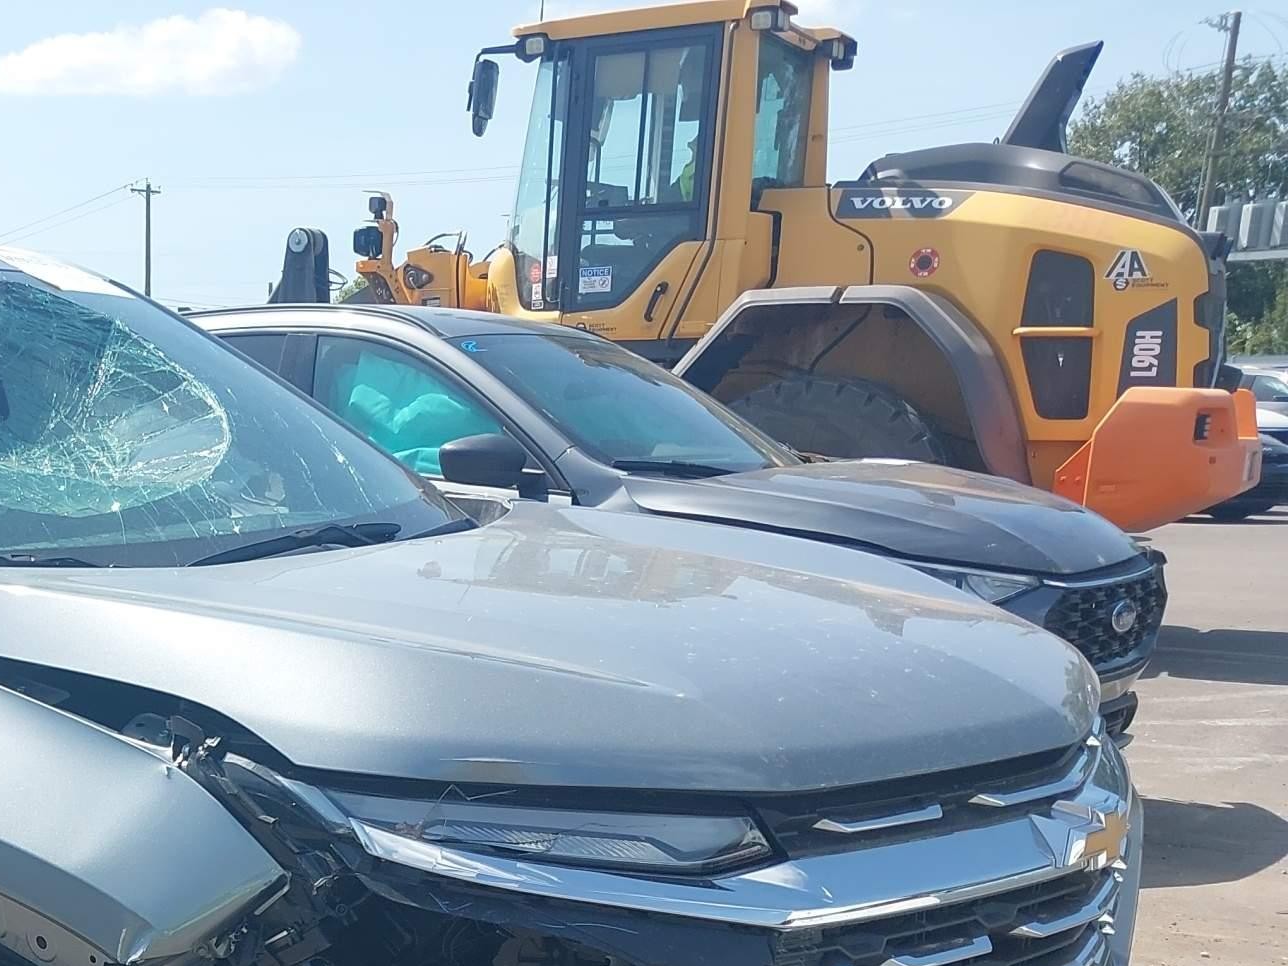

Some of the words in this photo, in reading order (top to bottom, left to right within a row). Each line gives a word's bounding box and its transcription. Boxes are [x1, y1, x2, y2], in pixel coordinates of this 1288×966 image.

[851, 197, 953, 209] VOLVO
[582, 268, 609, 277] NOTICE
[1130, 330, 1163, 377] L90H
